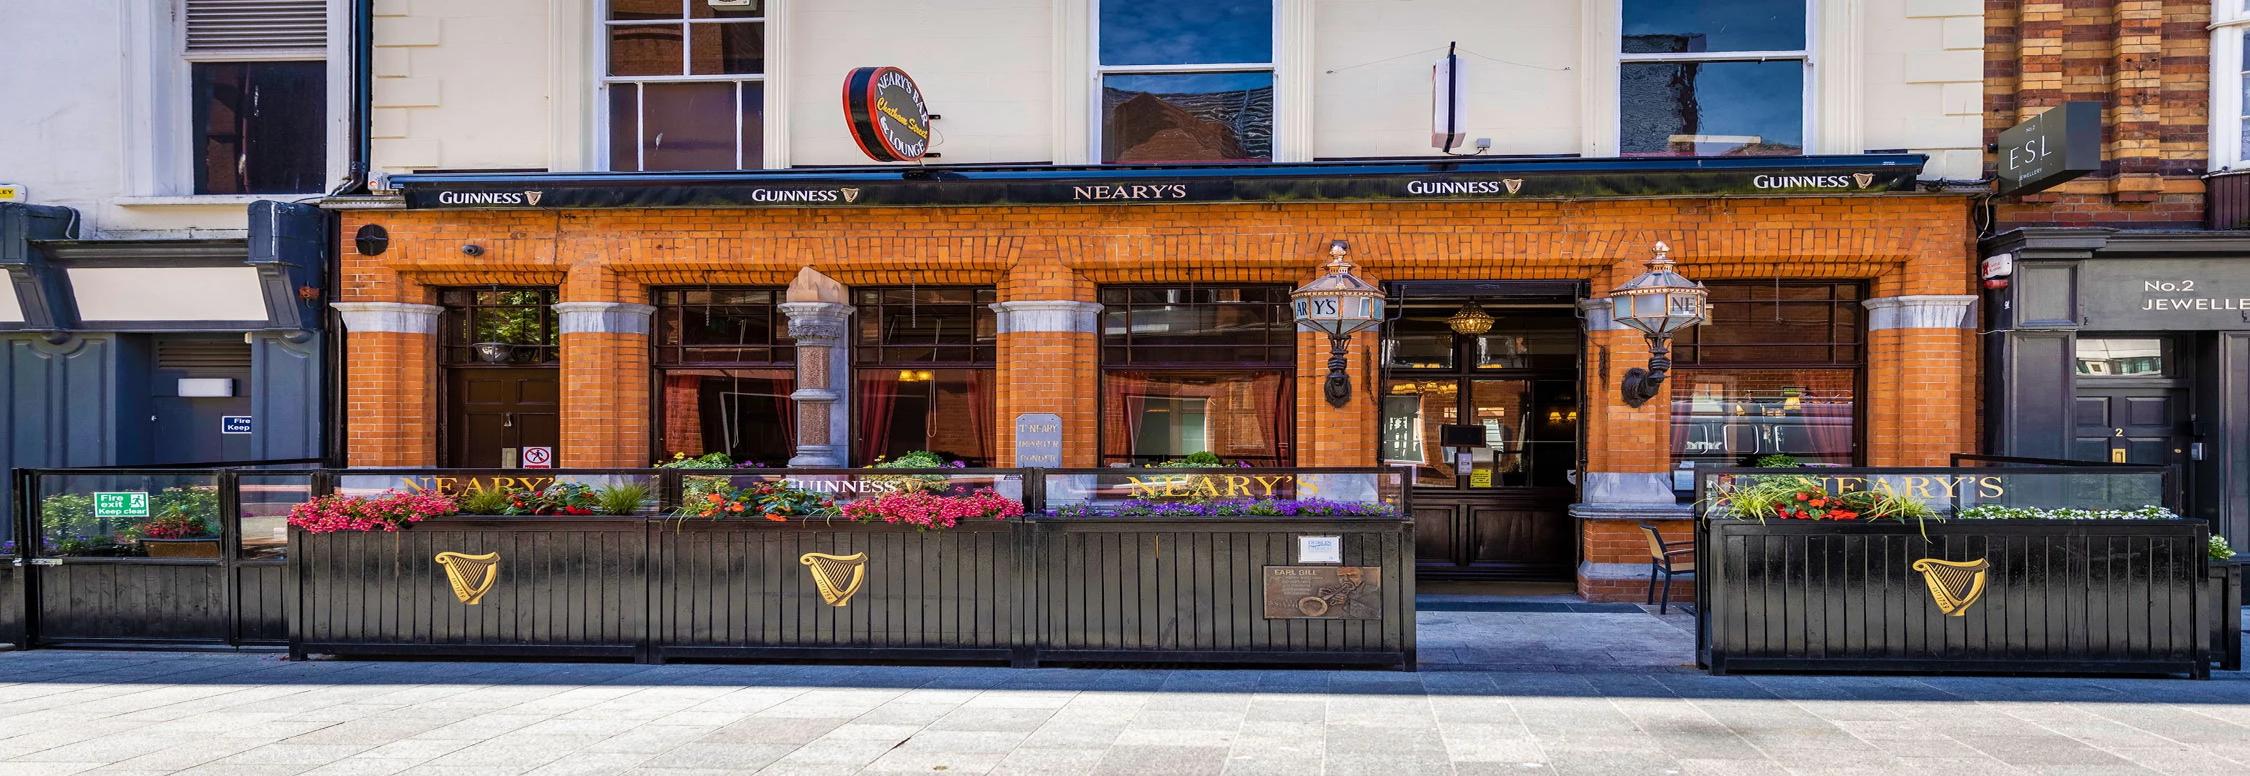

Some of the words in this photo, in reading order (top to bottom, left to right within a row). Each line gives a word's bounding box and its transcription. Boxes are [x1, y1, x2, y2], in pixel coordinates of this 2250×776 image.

[878, 72, 913, 95] NEARY'S
[913, 89, 928, 127] BAR
[877, 97, 908, 126] Chatham
[908, 118, 929, 139] Street
[889, 129, 925, 157] LOUNGE
[2009, 135, 2052, 171] ESL
[1407, 180, 1500, 194] GUINNESS
[1754, 174, 1850, 189] GUINNESS
[438, 191, 522, 204] GUINNESS
[752, 188, 838, 202] GUINNESS
[1073, 184, 1187, 200] NEARY'S
[2144, 280, 2194, 292] No.2
[2141, 299, 2250, 311] JEWELLE
[2115, 428, 2124, 437] 2
[401, 477, 577, 497] NEARY'
[798, 480, 897, 493] UINNESS
[1126, 476, 1319, 497] NEARY'S
